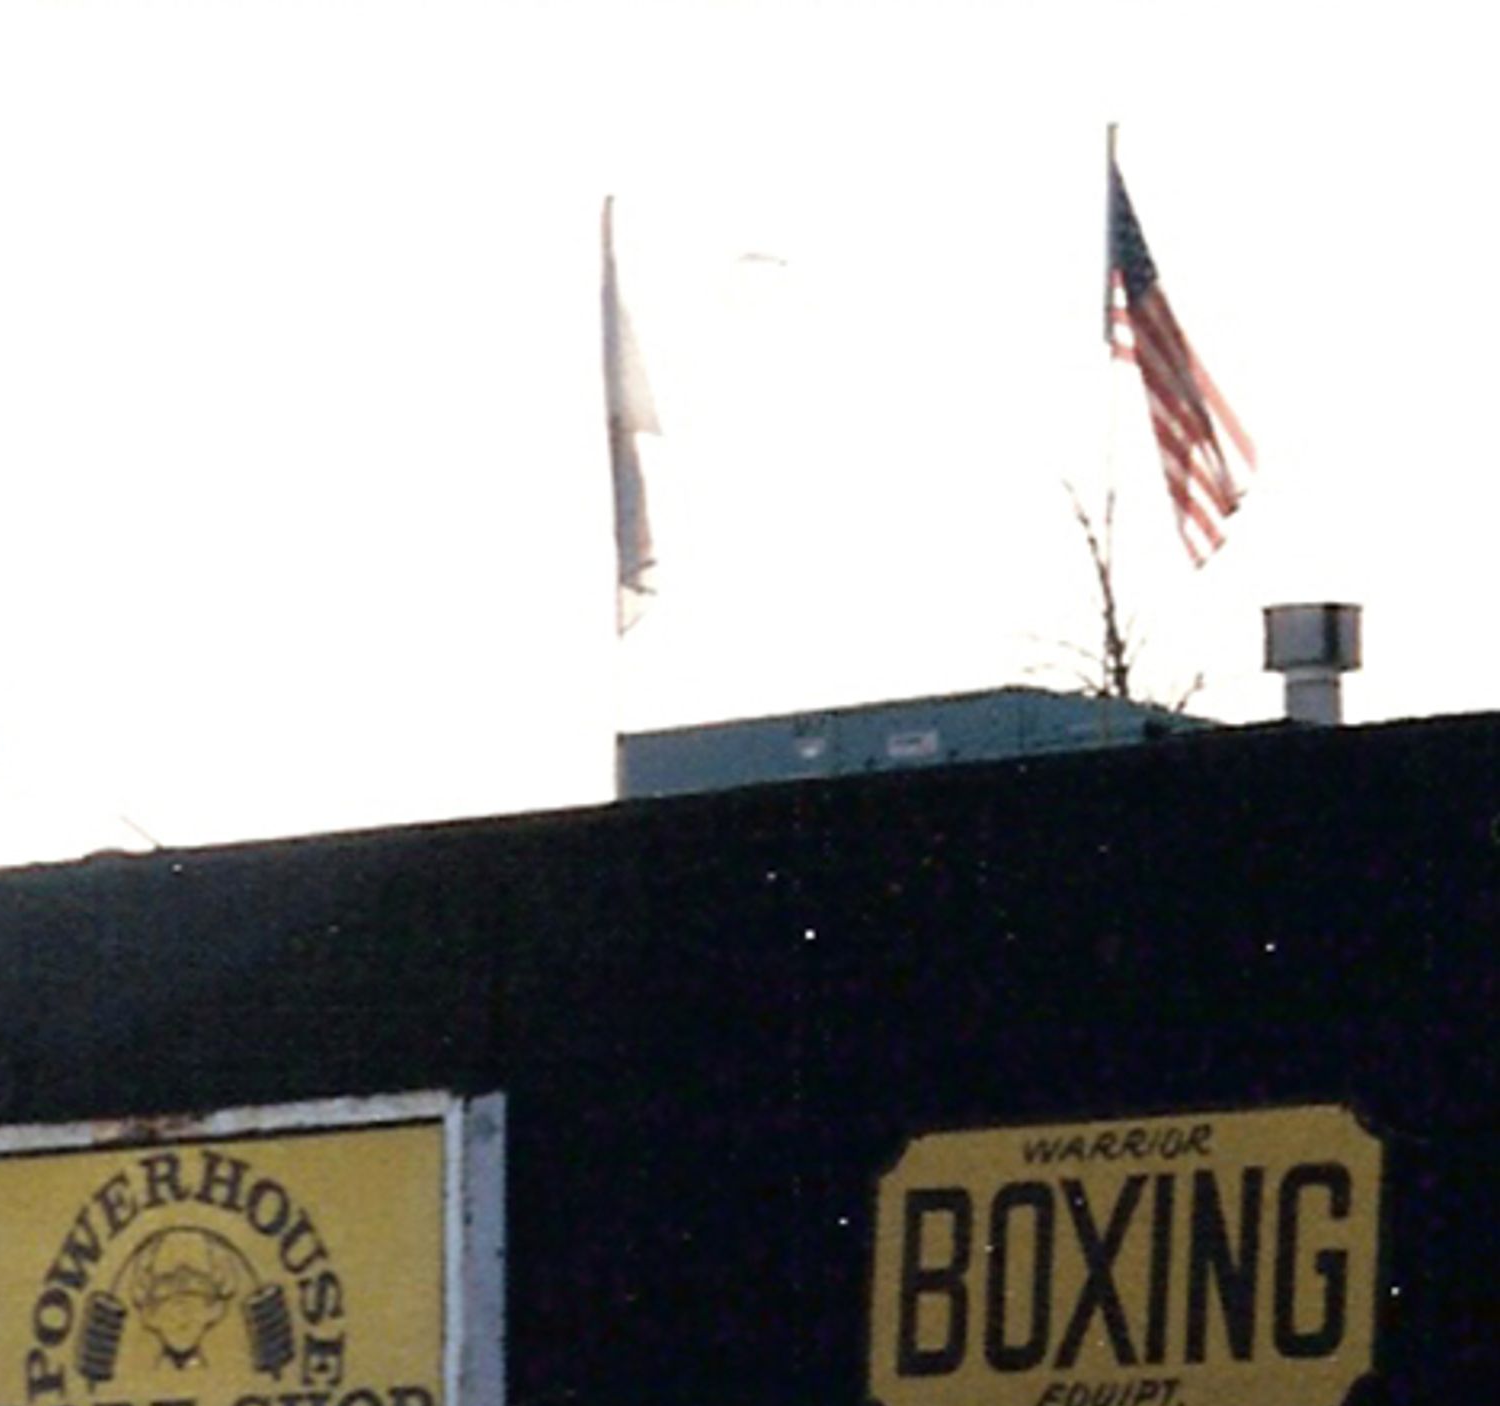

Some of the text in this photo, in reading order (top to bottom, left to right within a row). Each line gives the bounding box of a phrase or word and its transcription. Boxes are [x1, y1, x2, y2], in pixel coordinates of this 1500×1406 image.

[1024, 1124, 1212, 1164] WARRIOR
[25, 1150, 346, 1401] POWERHOUSE
[896, 1162, 1352, 1378] BOXING
